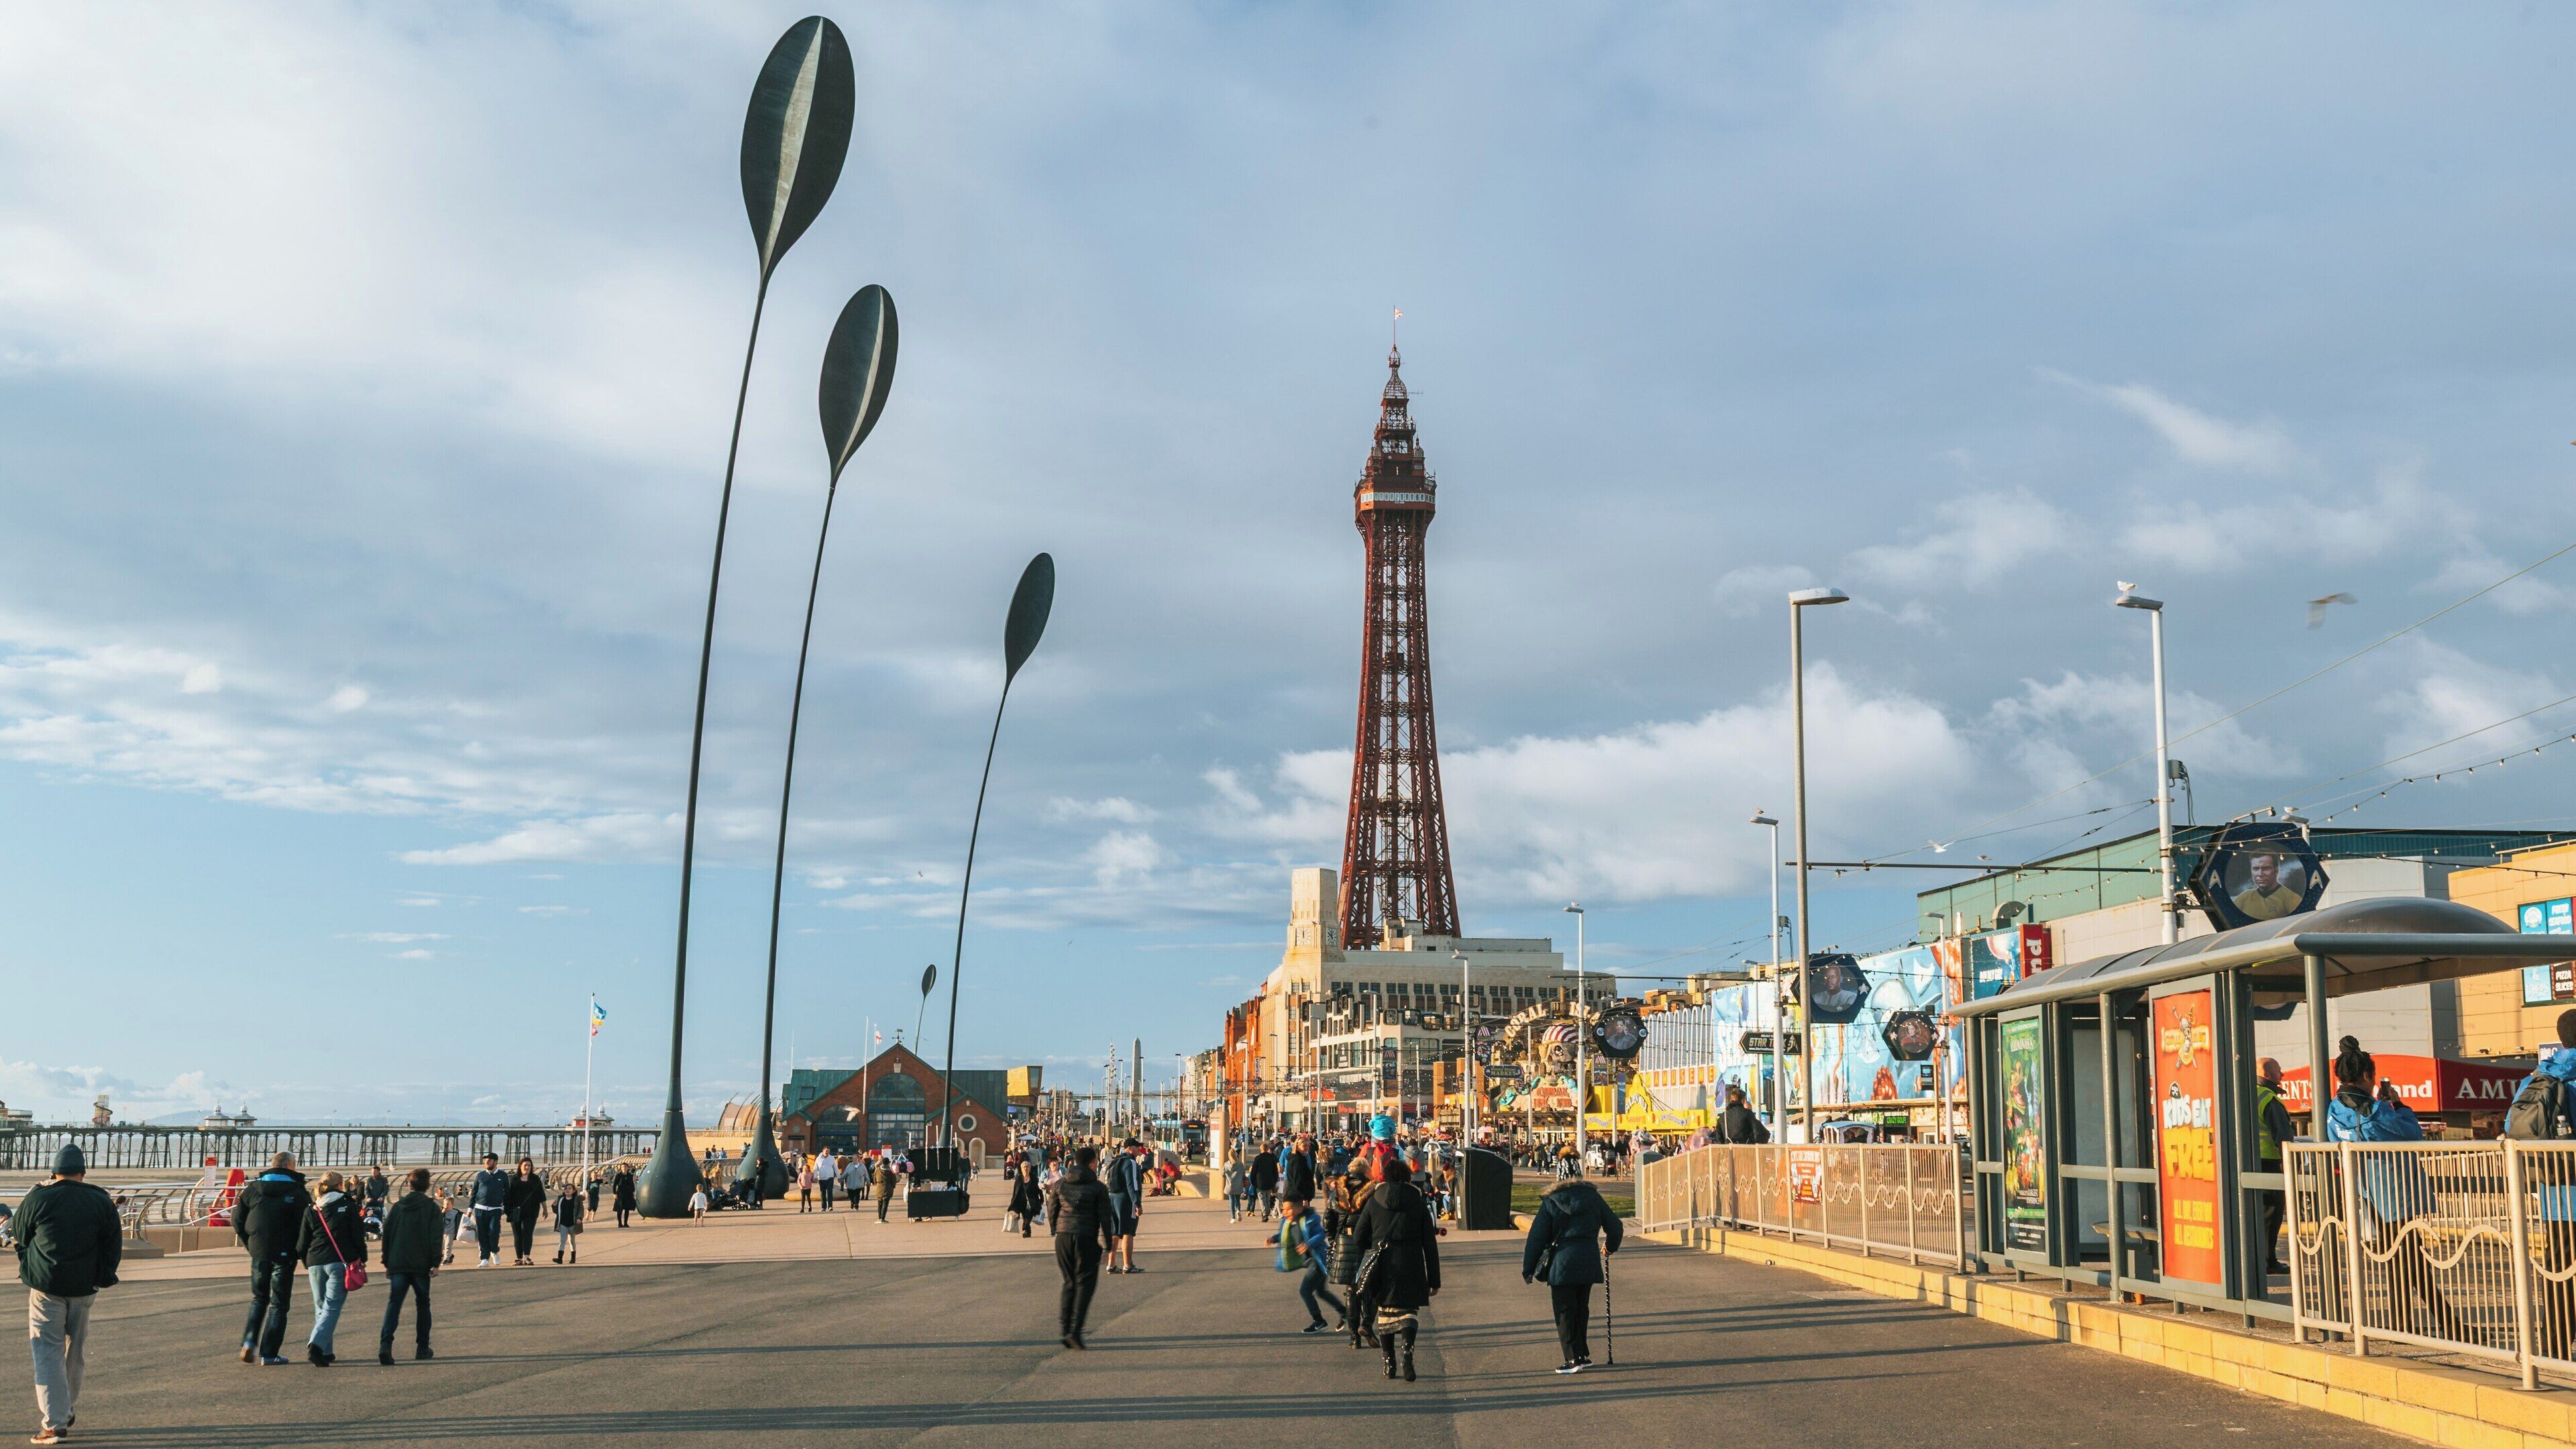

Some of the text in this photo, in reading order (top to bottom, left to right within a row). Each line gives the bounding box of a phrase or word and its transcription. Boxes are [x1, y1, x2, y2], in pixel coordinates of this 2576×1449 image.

[2555, 970, 2572, 980] PIZZA
[2555, 981, 2574, 991] SLICES
[1505, 1004, 1547, 1038] CORAL
[1749, 1037, 1768, 1047] STAR
[2163, 1094, 2212, 1130] KIDS EAT
[1886, 1116, 1897, 1124] CRAZY
[2163, 1127, 2215, 1181] FREE
